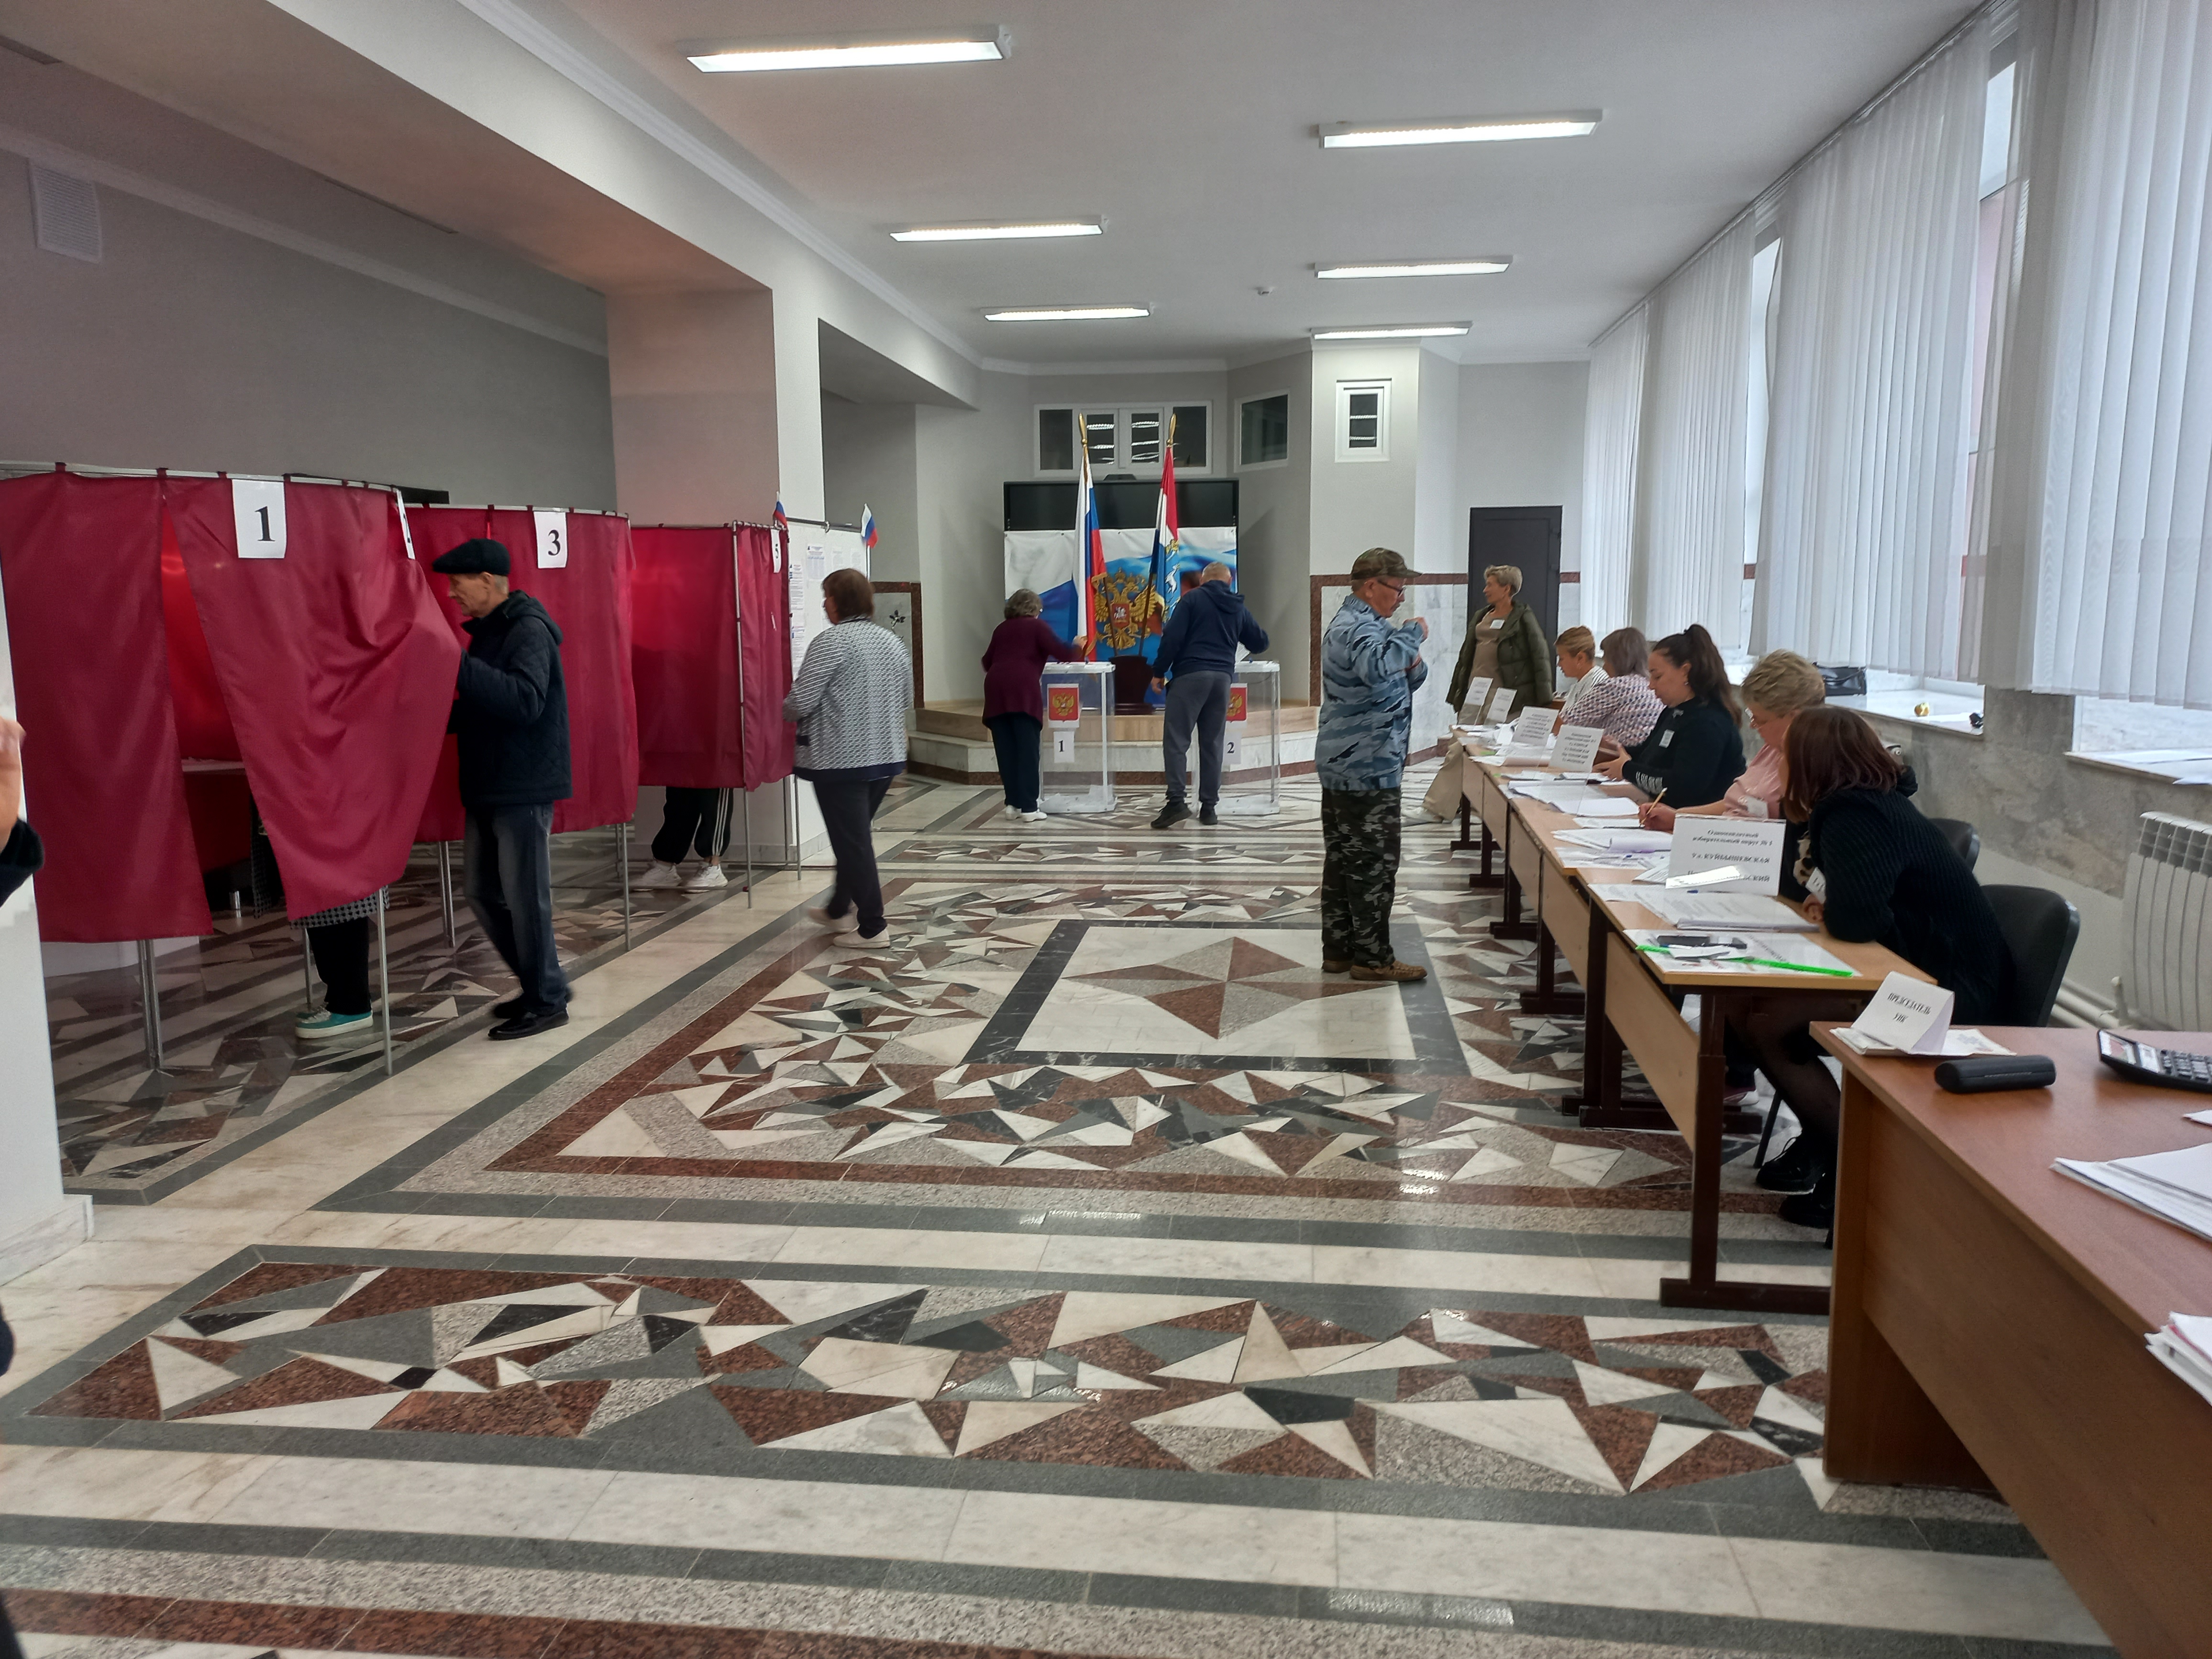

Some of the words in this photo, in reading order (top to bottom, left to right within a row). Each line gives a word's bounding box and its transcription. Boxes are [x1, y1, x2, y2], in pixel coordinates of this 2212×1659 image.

[254, 506, 275, 542] 1
[548, 529, 561, 556] 3
[1058, 740, 1064, 752] 1
[1227, 742, 1235, 754] 2
[1888, 992, 1931, 1015] ПРЕДСЕДАТЕЛЬ
